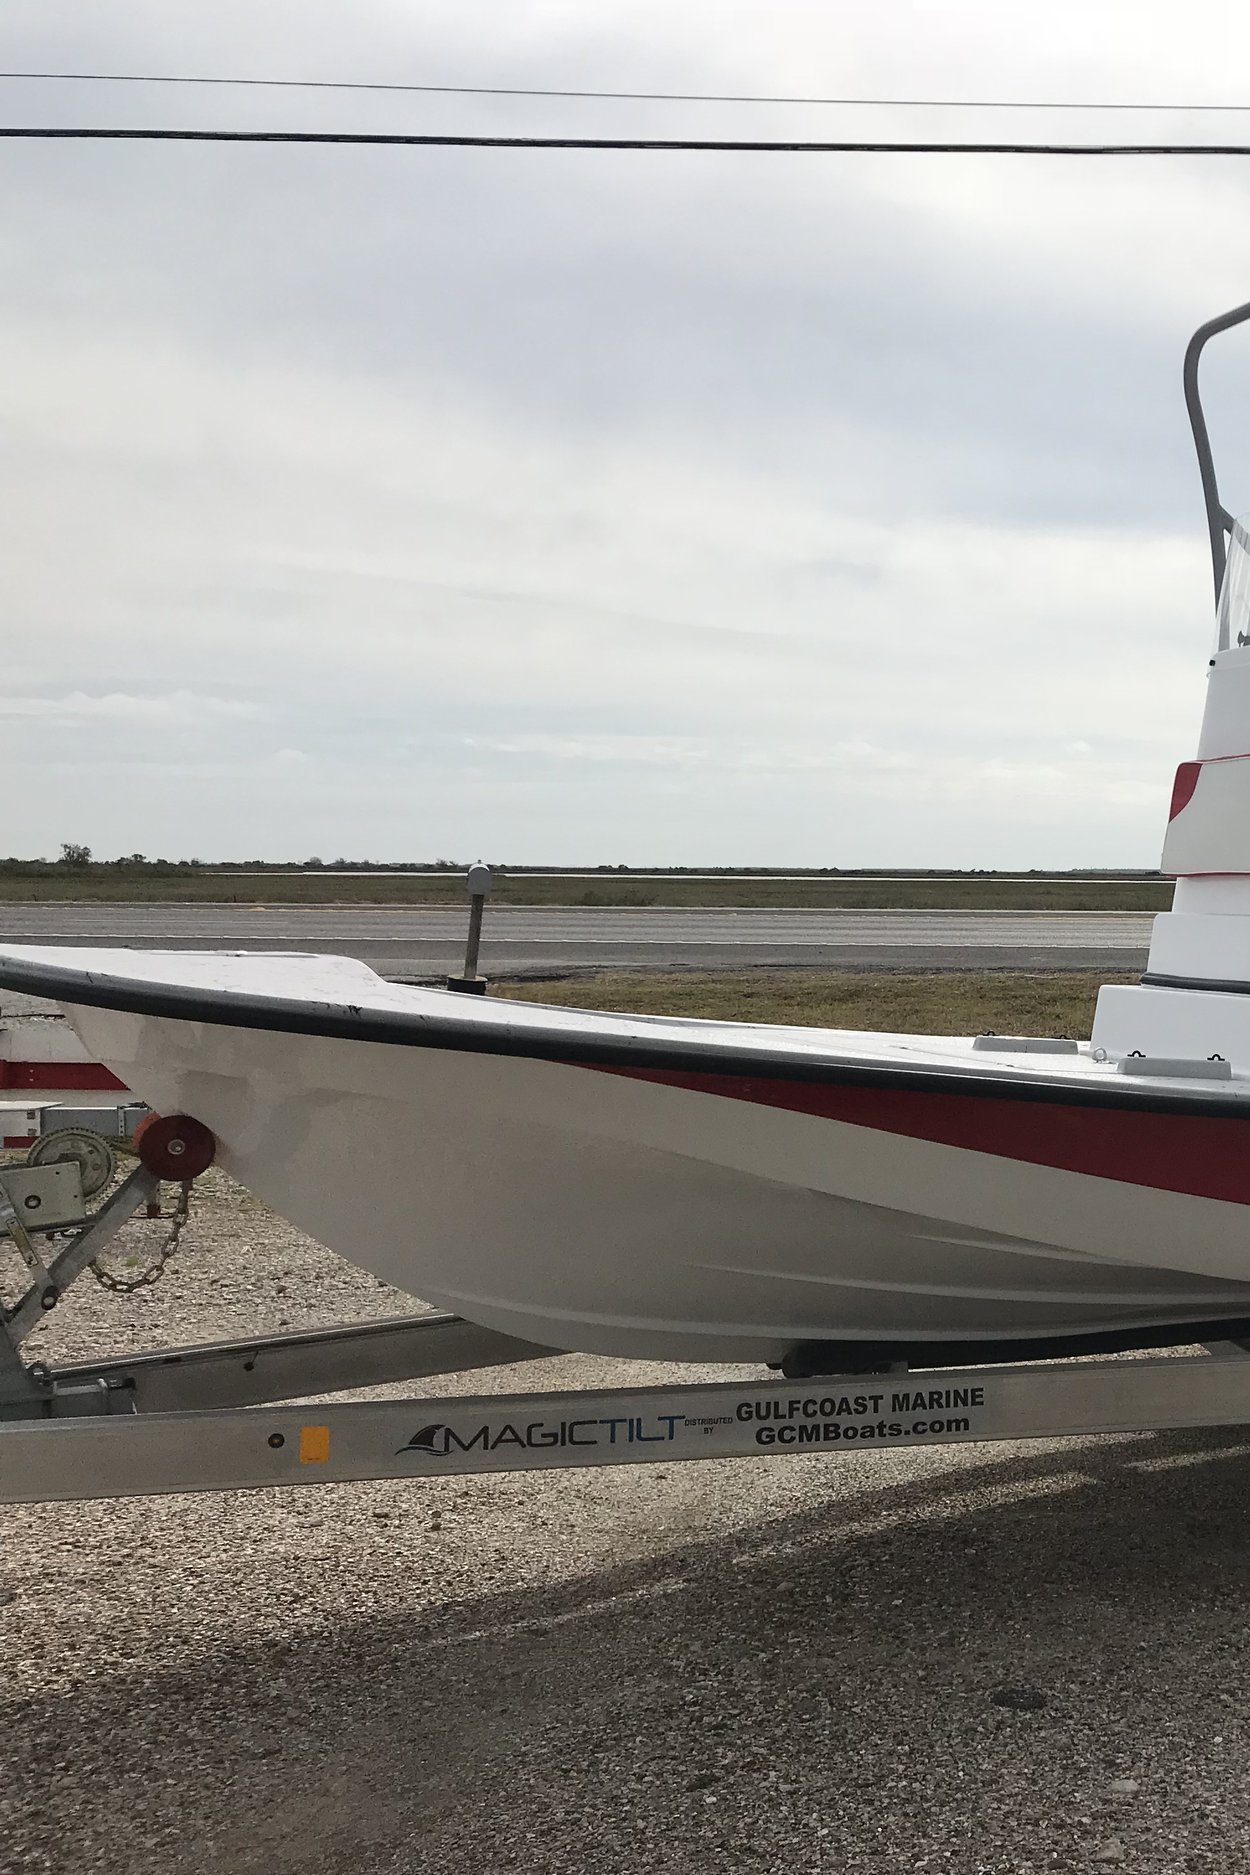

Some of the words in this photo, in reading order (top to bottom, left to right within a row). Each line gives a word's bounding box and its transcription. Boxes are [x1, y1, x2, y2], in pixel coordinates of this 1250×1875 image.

[736, 1395, 883, 1422] GULFCOAST
[892, 1387, 985, 1412] MARINE
[444, 1415, 685, 1451] MAGICTILT
[684, 1417, 733, 1426] DISTRIBUTED
[755, 1416, 970, 1445] GCMBoats.com
